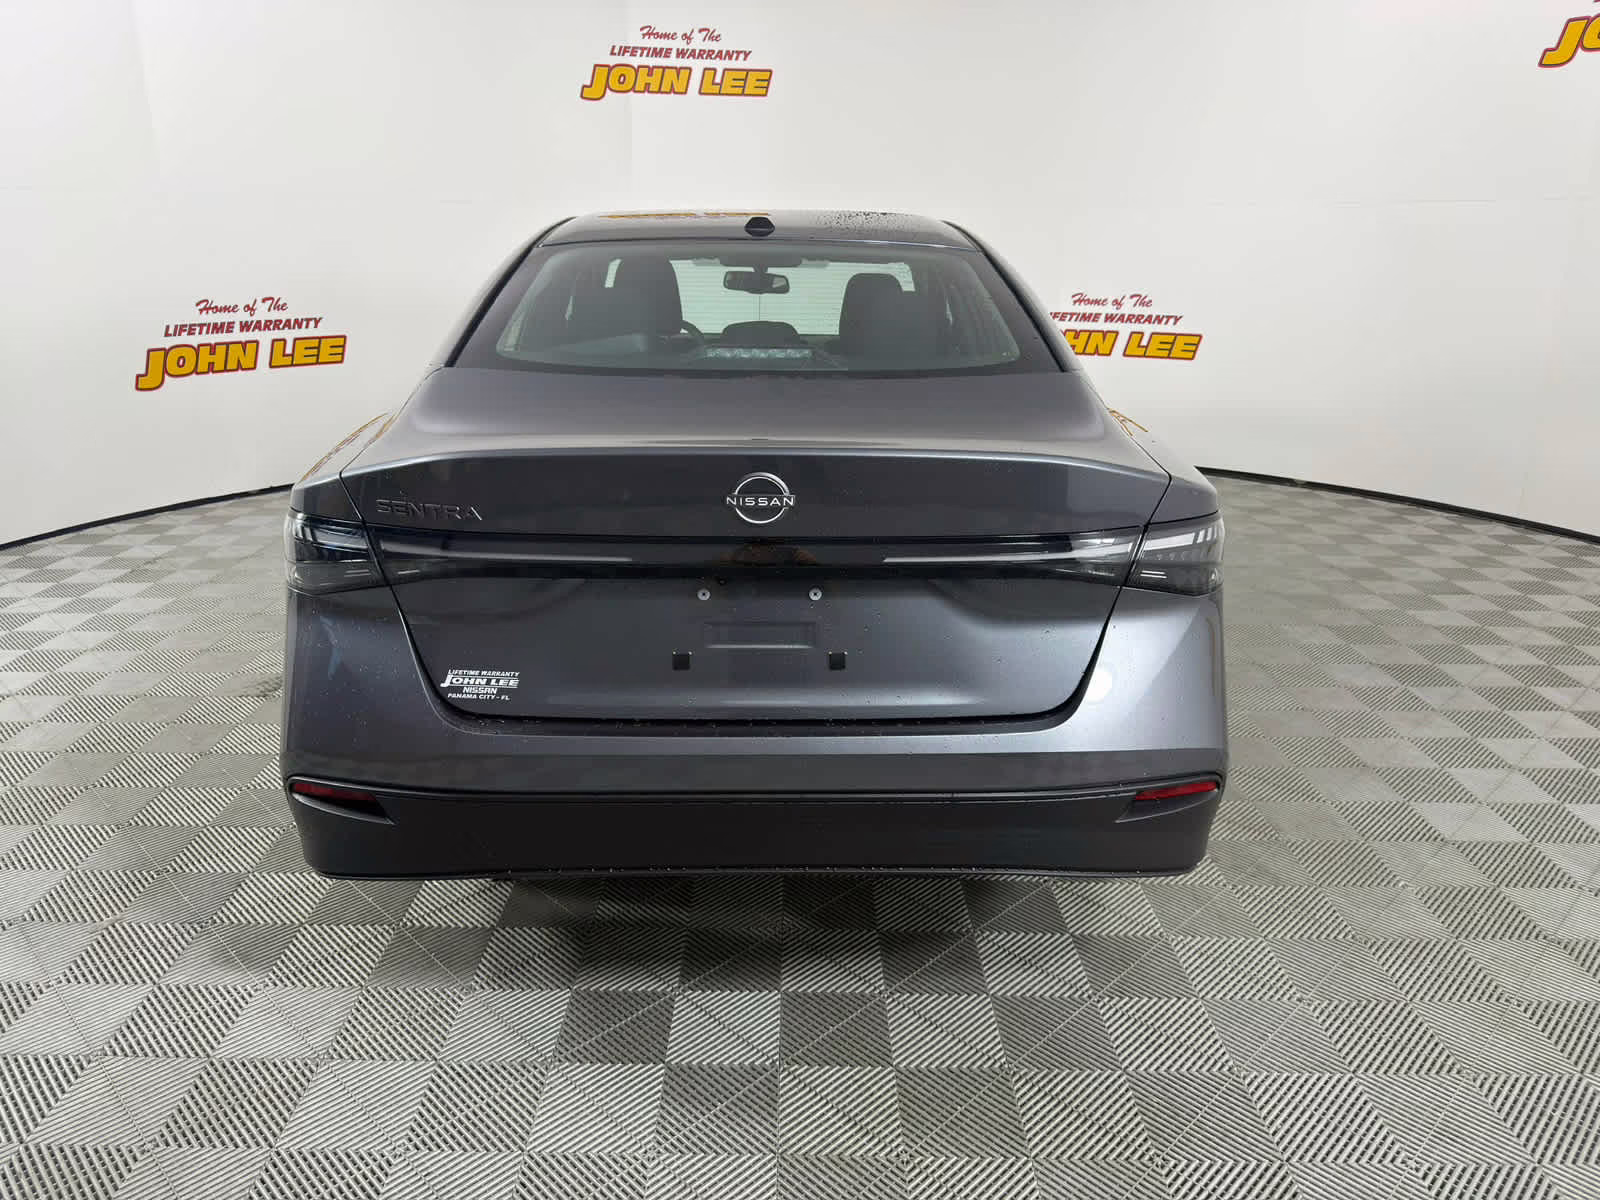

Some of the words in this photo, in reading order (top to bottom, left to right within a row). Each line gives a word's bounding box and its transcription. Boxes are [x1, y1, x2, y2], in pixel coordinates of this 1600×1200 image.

[640, 25, 678, 41] Home
[681, 28, 695, 45] of
[698, 27, 722, 42] The
[609, 45, 673, 59] LIFETIME
[675, 47, 752, 62] WARRANTY
[580, 63, 693, 101] JOHN
[698, 67, 773, 97] LEE
[195, 298, 240, 316] Home
[243, 298, 257, 317] of
[261, 296, 289, 313] The
[1071, 292, 1109, 307] Home
[1111, 295, 1126, 310] of
[1129, 293, 1153, 308] The
[164, 320, 236, 338] LIFETIME
[238, 316, 323, 334] WARRANTY
[1103, 312, 1184, 326] WARRANTY
[1060, 328, 1120, 357] HN
[1122, 331, 1203, 361] LEE
[135, 339, 260, 392] JOHN
[268, 335, 347, 369] LEE
[376, 498, 483, 521] SENTRA
[726, 496, 794, 507] NISSAN
[440, 674, 488, 688] JOHN
[490, 678, 520, 687] LEE
[462, 686, 498, 694] NISSAN
